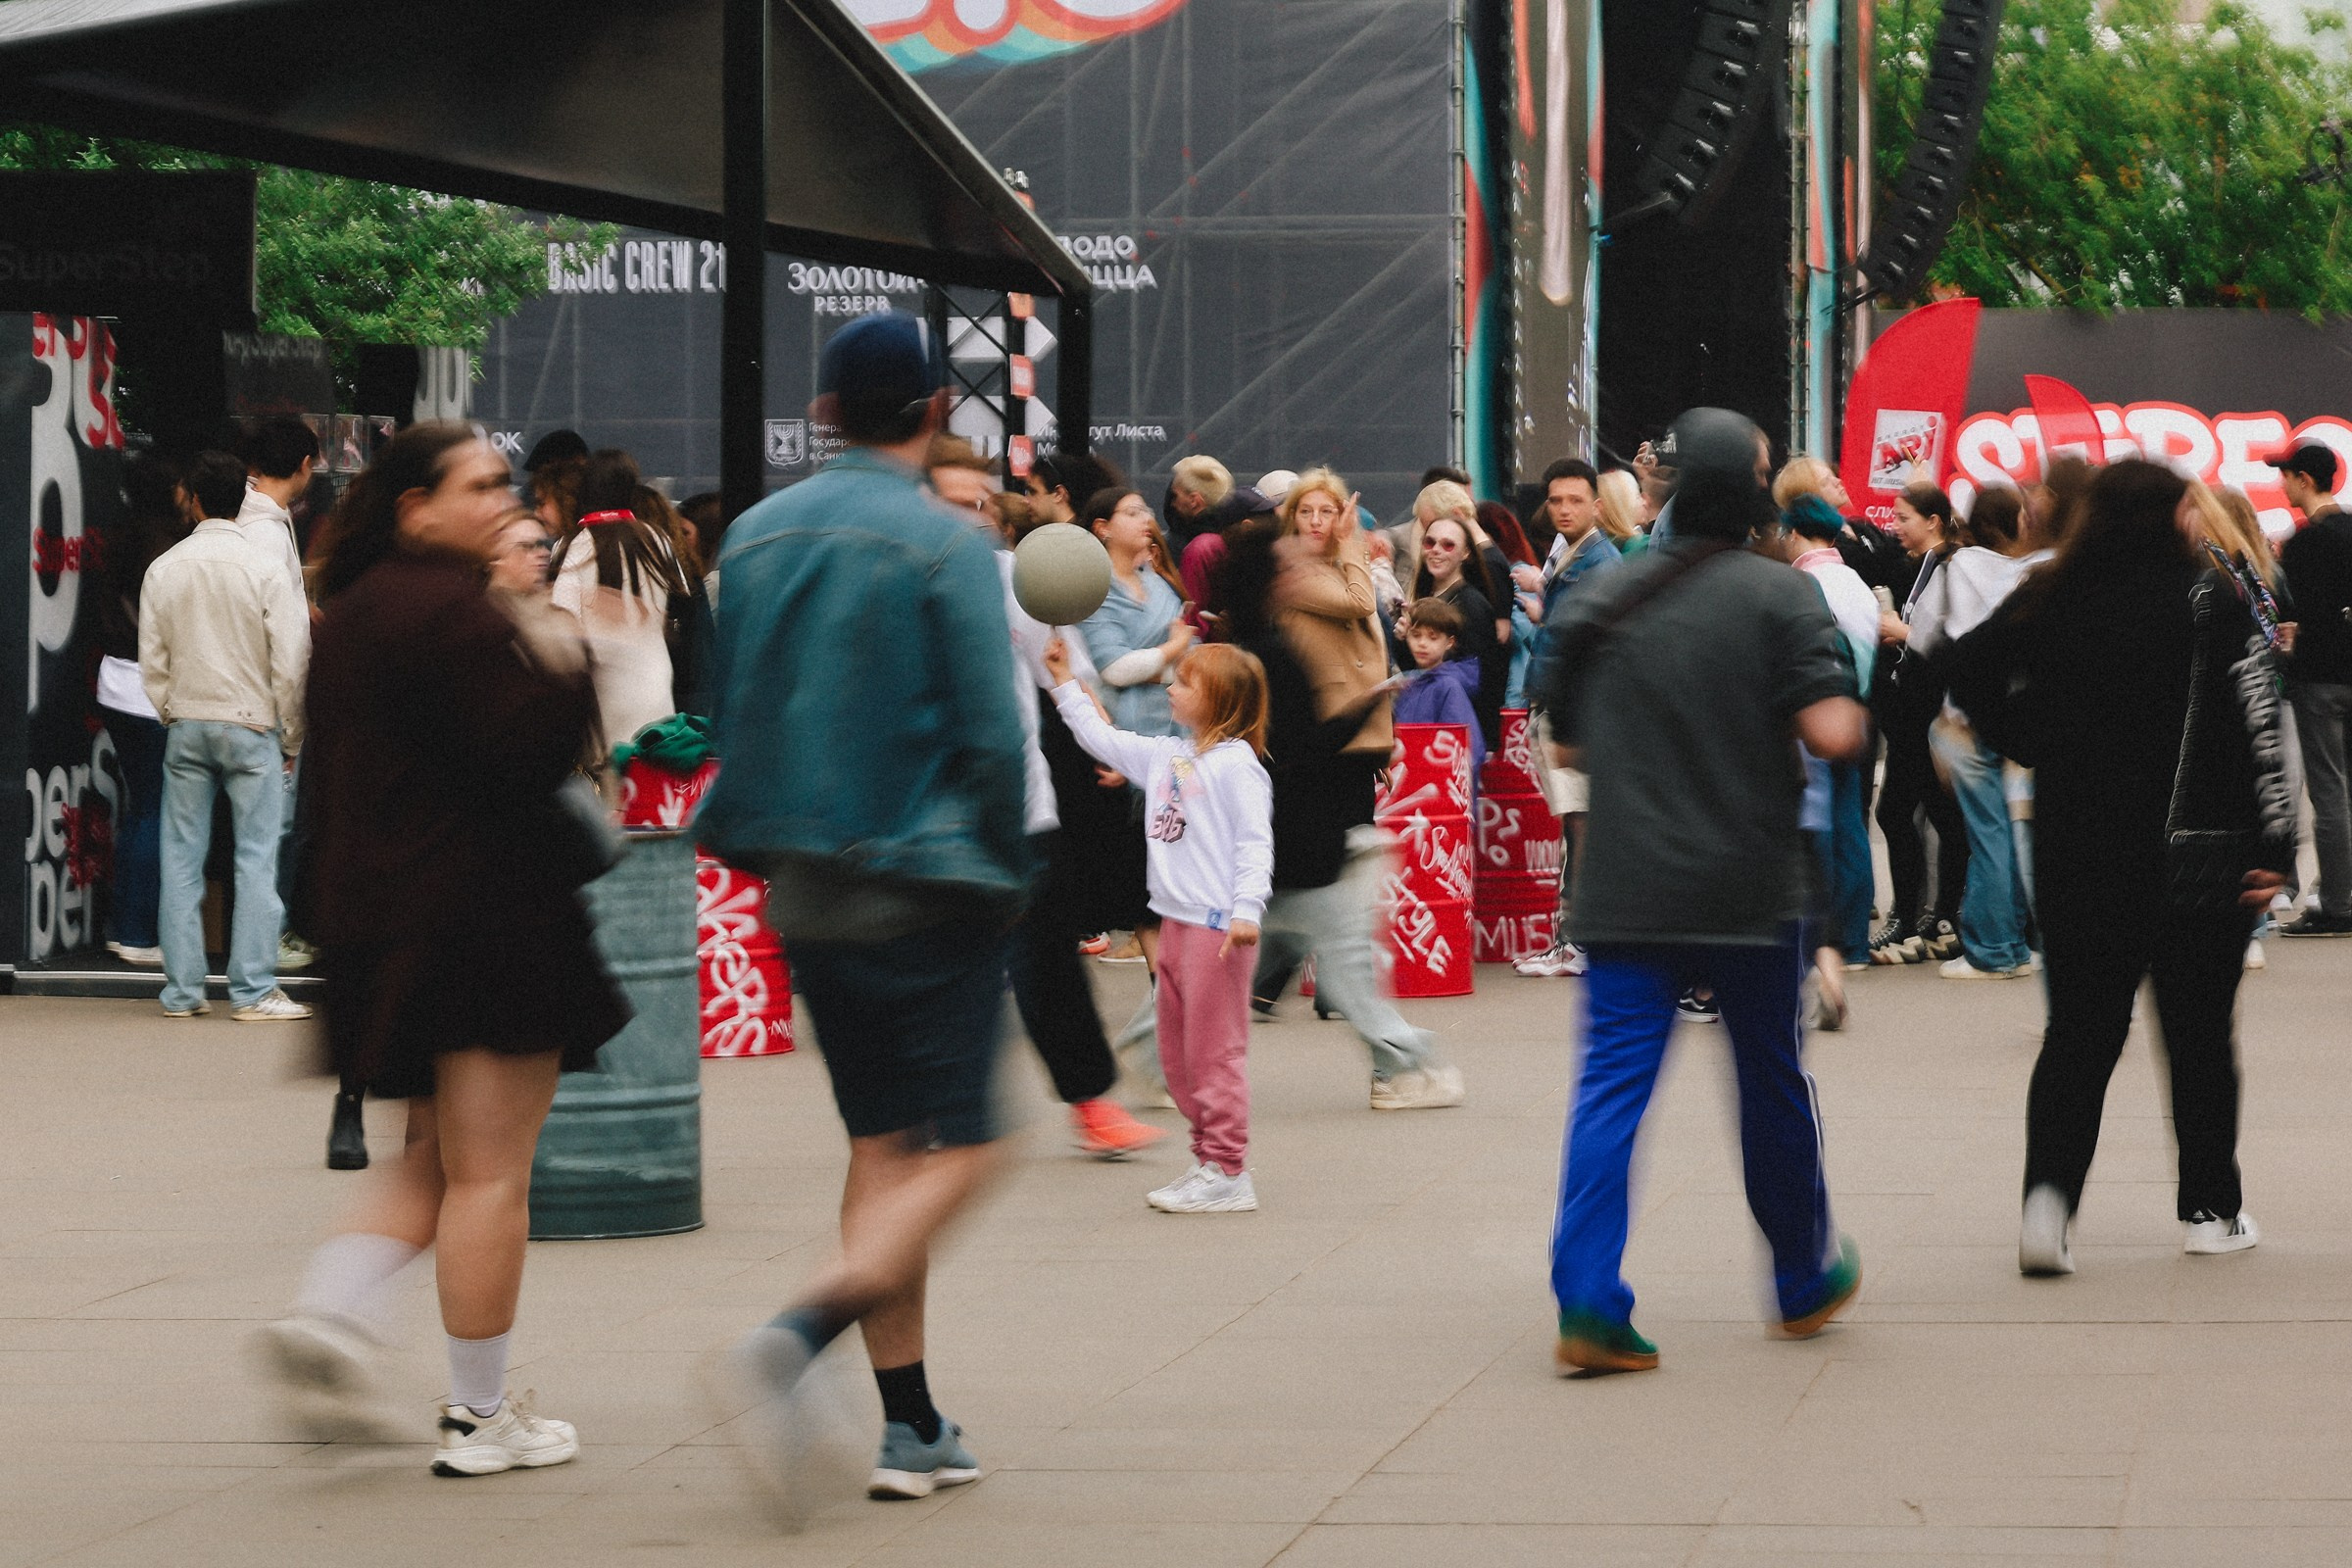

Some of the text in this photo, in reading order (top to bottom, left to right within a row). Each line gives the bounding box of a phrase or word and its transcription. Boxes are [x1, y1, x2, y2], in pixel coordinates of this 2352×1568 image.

[624, 240, 692, 292] CREW
[1083, 265, 1156, 290] ЦЦА
[813, 295, 893, 314] РЕЗЕРВ
[808, 422, 842, 433] Генера
[1115, 423, 1163, 437] Листа
[1865, 505, 1896, 518] СЛУ
